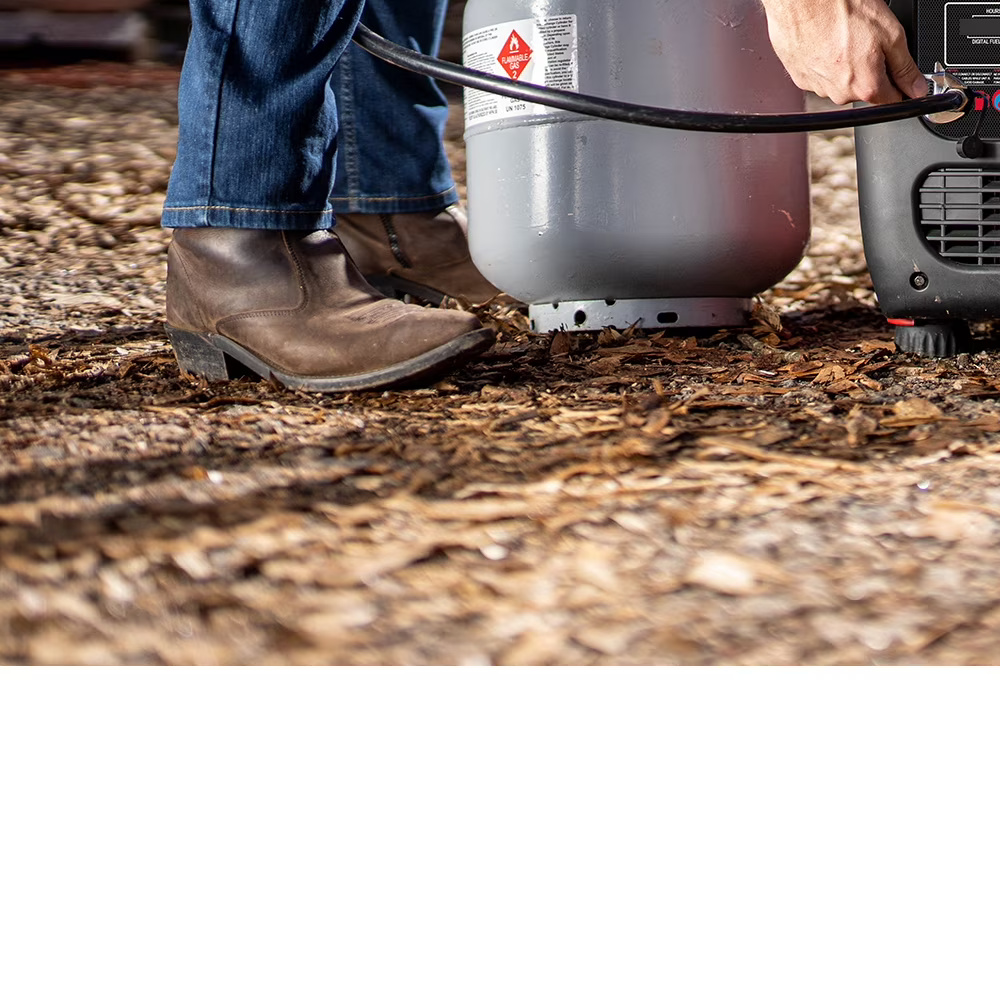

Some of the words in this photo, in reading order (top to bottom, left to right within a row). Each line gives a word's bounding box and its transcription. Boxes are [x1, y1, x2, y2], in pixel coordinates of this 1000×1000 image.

[501, 53, 529, 64] FLAMMABLE
[510, 61, 520, 70] GAS
[512, 70, 517, 78] 2
